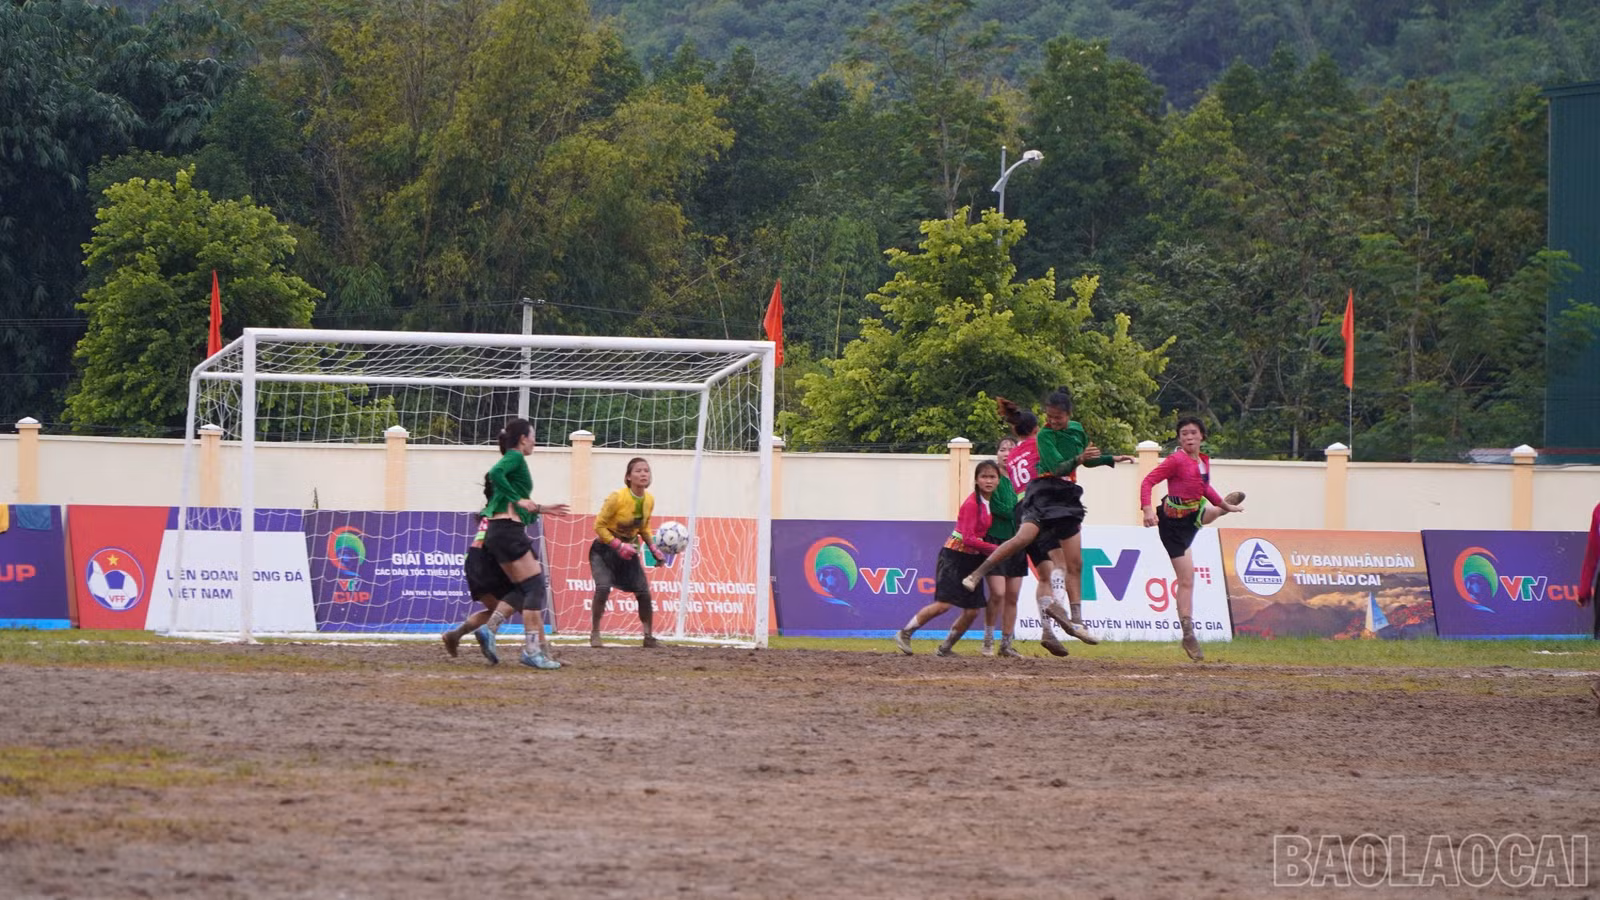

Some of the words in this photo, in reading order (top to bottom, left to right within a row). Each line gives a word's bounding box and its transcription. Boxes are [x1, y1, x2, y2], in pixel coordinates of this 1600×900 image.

[1010, 459, 1031, 488] 16
[1312, 554, 1342, 567] BAN
[1343, 553, 1385, 568] NHÂN
[1386, 553, 1415, 568] DÂN
[166, 567, 196, 581] LÊN
[284, 567, 304, 582] ĐÁ
[374, 567, 391, 576] CÁC
[391, 567, 409, 576] DÂN
[1330, 571, 1357, 586] LÀO
[1358, 574, 1382, 586] CAI
[337, 578, 363, 591] VTV
[708, 580, 756, 596] THÔNG
[859, 568, 918, 594] VTV
[201, 587, 233, 599] NAM
[1499, 576, 1548, 602] VTV
[1547, 585, 1580, 601] CU
[108, 595, 126, 603] VFF
[332, 591, 371, 603] CUP
[583, 598, 614, 612] DN
[705, 600, 744, 614] THÔN
[1205, 621, 1223, 631] GIA
